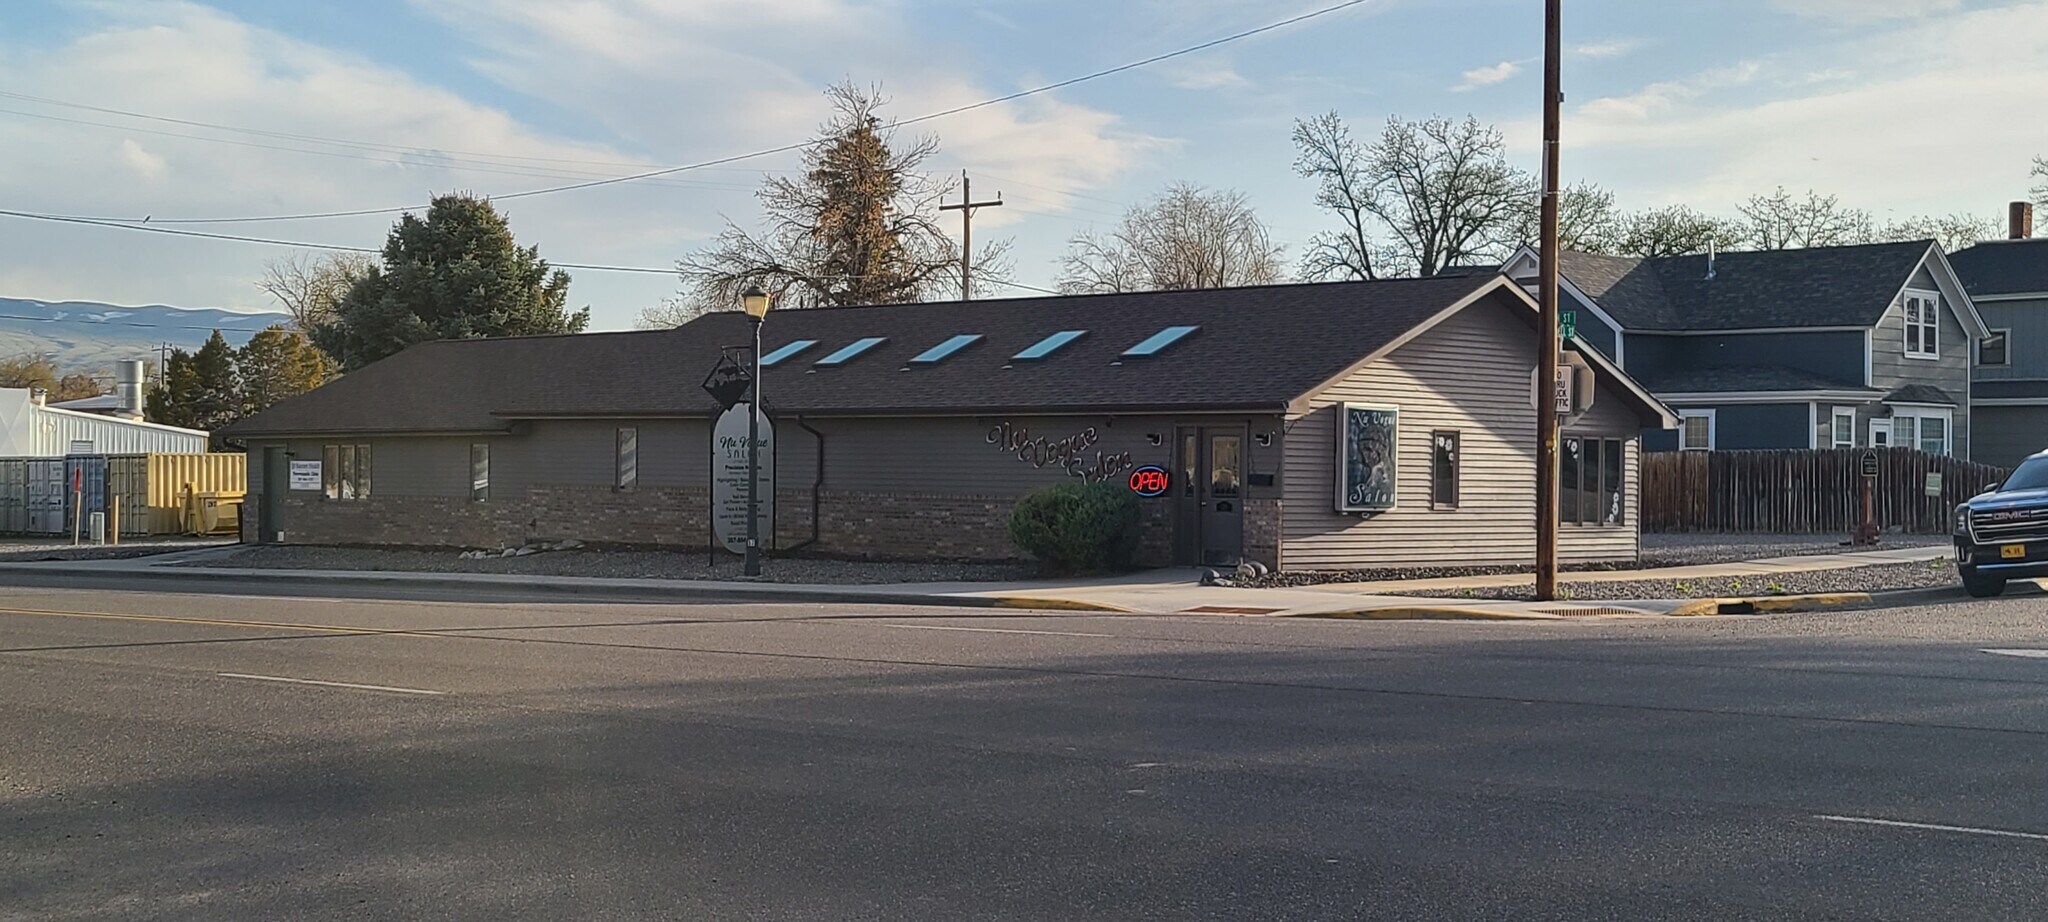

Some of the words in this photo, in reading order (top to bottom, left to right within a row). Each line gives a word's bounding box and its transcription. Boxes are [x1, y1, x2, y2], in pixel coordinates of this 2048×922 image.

[1563, 313, 1571, 323] ST
[1556, 380, 1566, 388] RU
[1555, 398, 1569, 407] FFIC
[1351, 411, 1369, 428] Nu
[1371, 411, 1396, 427] Vogu
[719, 436, 737, 450] Nu
[985, 421, 1028, 452] Nu
[1018, 427, 1098, 469] Vogue
[1067, 450, 1132, 486] Salon
[1129, 471, 1169, 491] OPEN
[1993, 510, 2030, 520] GMC
